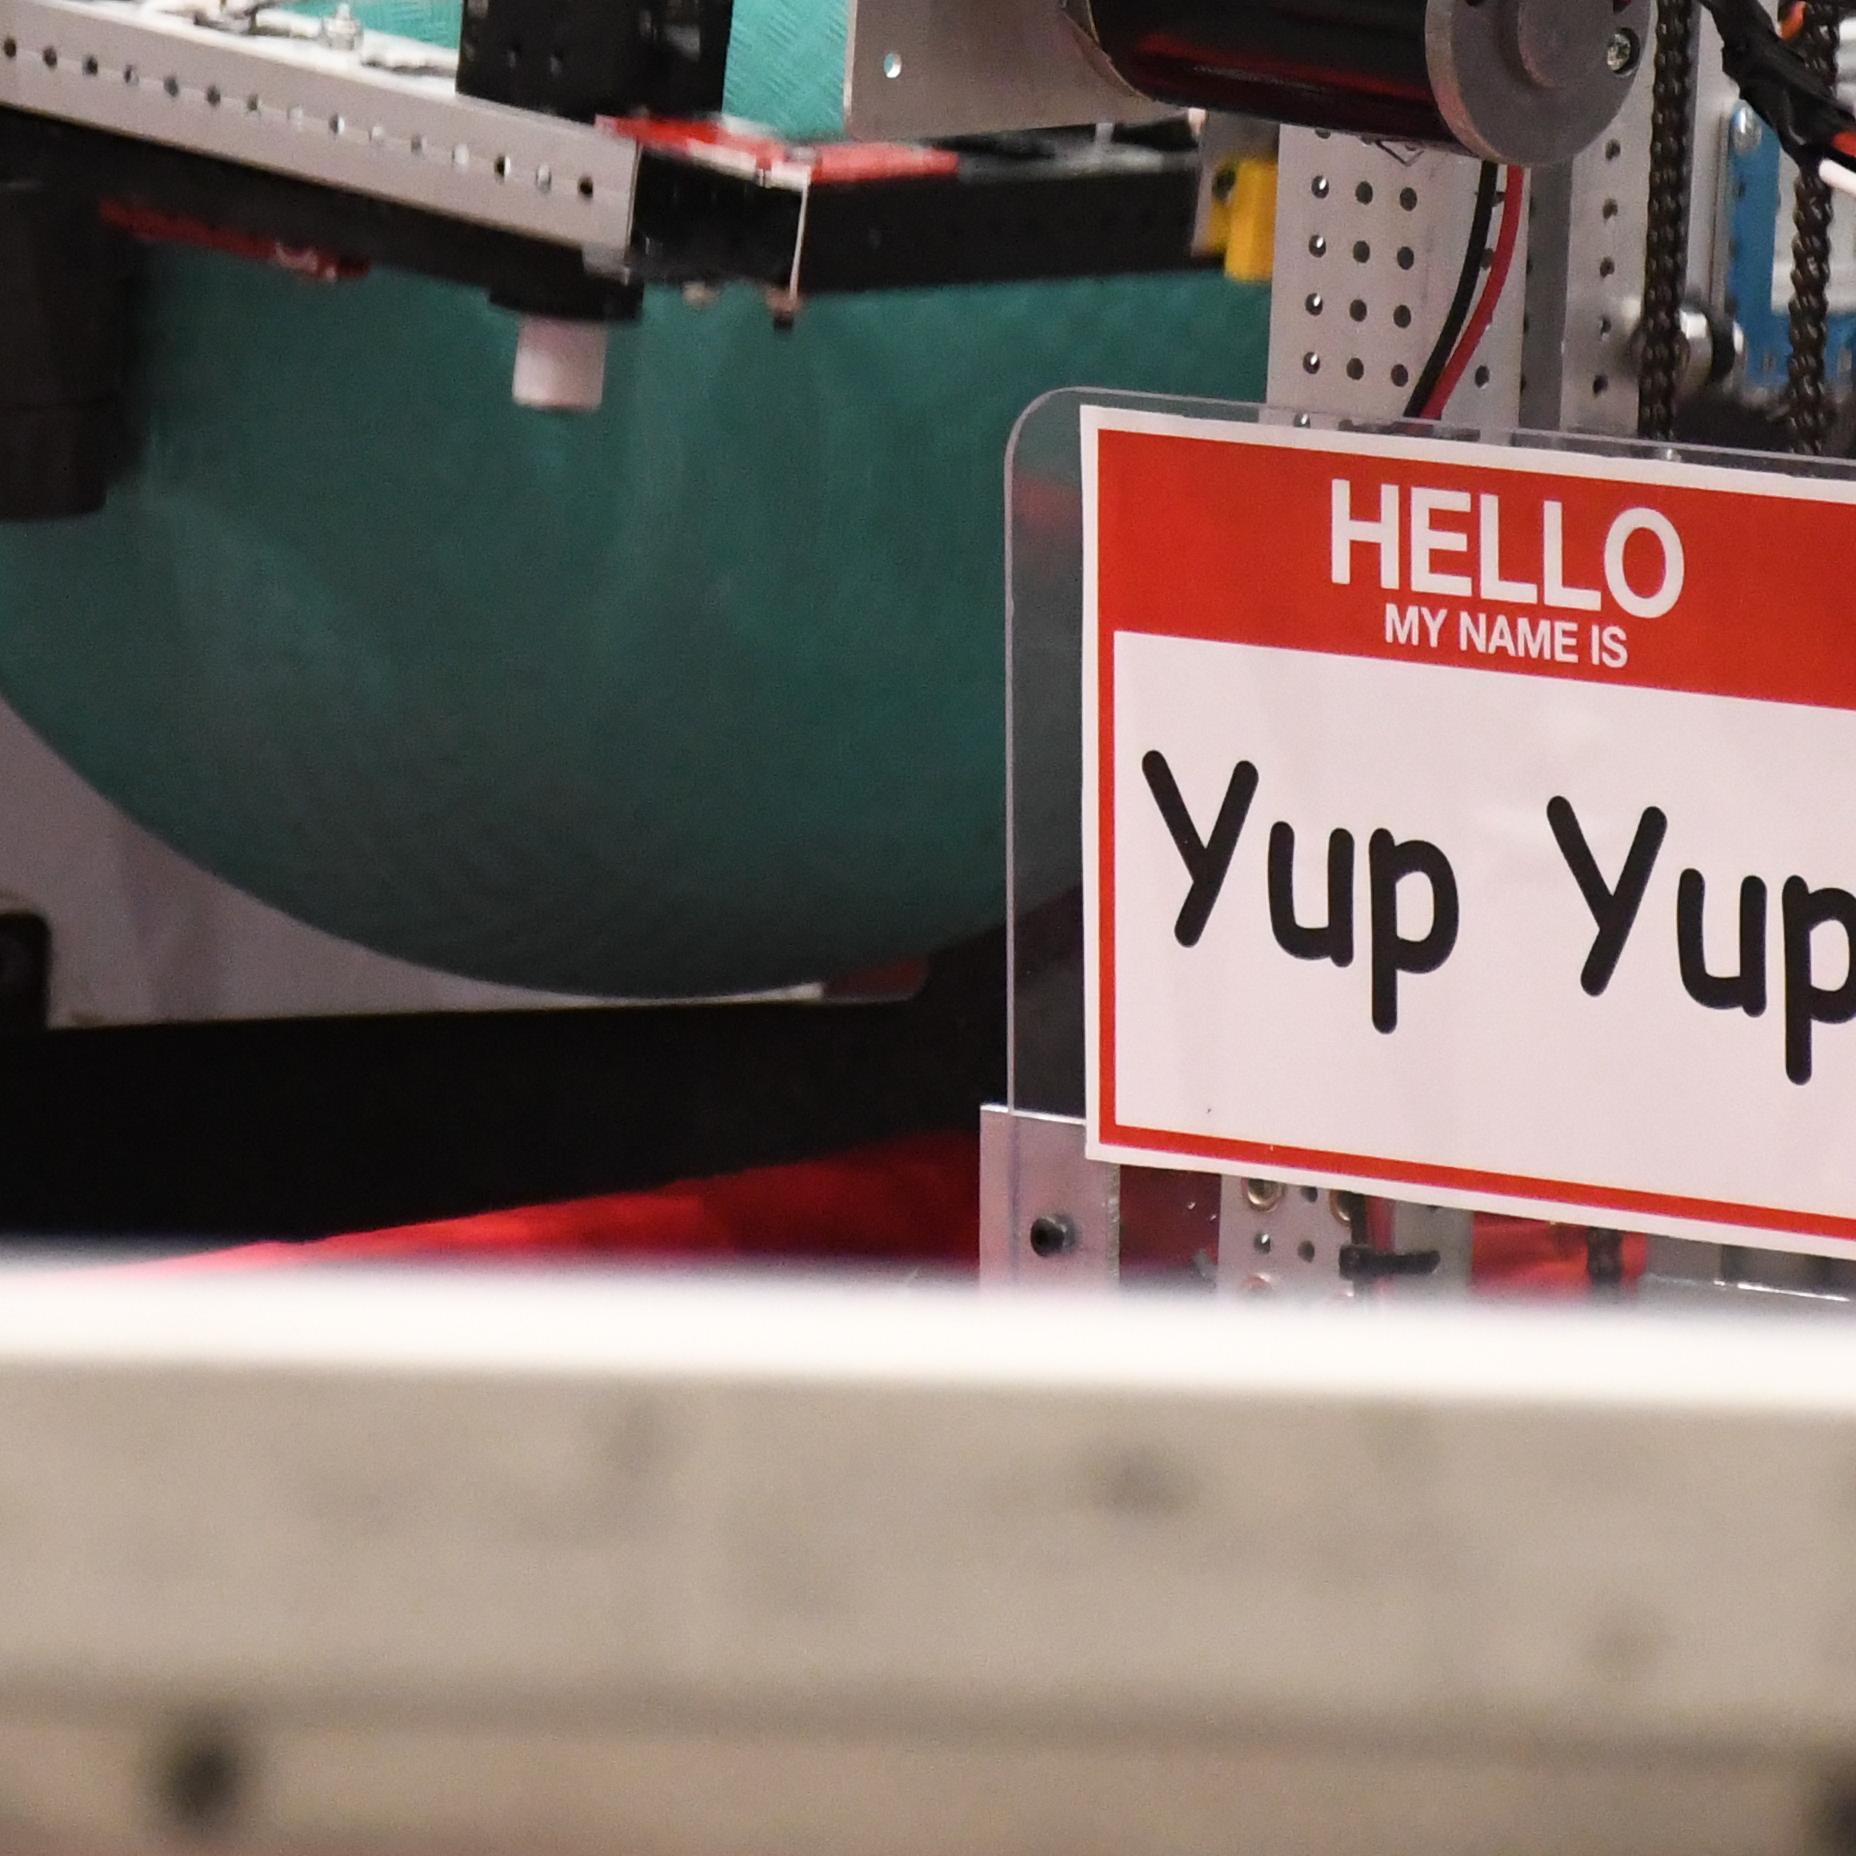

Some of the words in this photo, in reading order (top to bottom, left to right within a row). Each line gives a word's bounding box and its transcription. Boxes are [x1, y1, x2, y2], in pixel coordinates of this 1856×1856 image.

[1330, 478, 1685, 618] HELLO
[1383, 604, 1448, 651] MY
[1458, 610, 1579, 664] NAME
[1589, 624, 1629, 669] IS
[1141, 749, 1460, 1034] Yup
